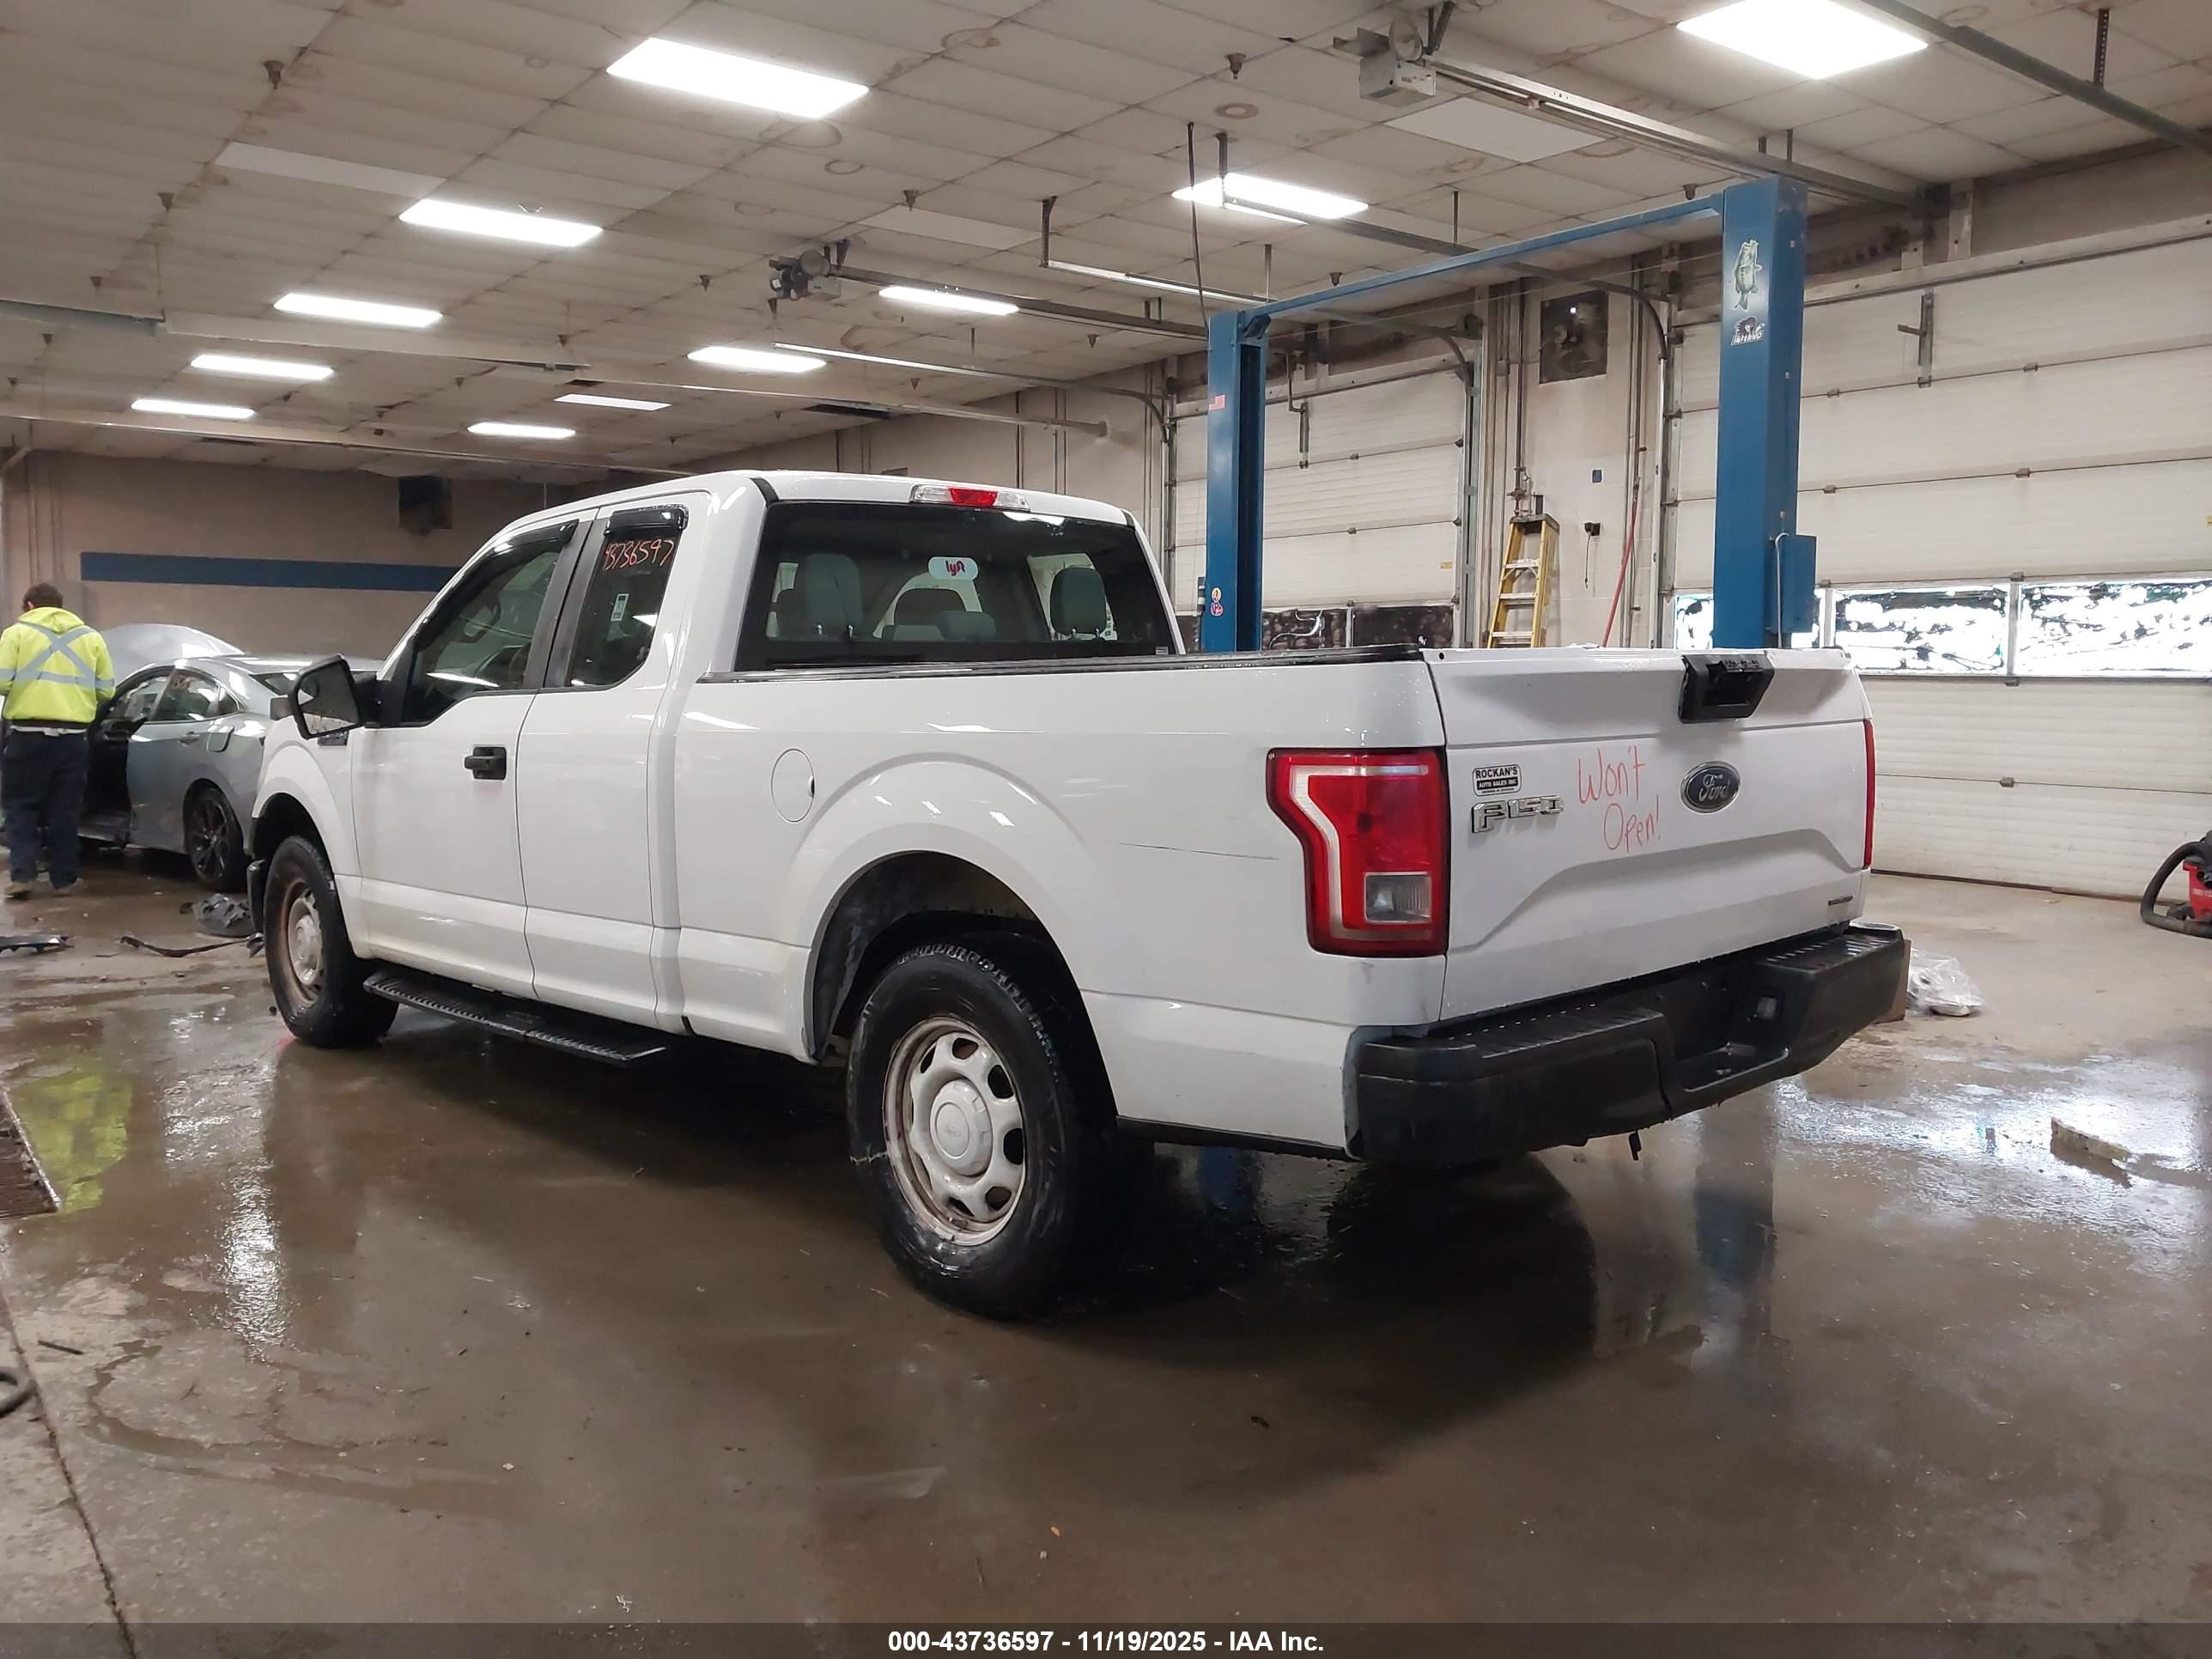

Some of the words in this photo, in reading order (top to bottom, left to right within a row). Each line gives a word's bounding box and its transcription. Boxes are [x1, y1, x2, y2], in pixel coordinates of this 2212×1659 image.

[1475, 766, 1517, 780] ROCKAN'S
[1577, 744, 1646, 804] Won't
[1698, 770, 1729, 801] Ford
[1603, 793, 1662, 854] Open!
